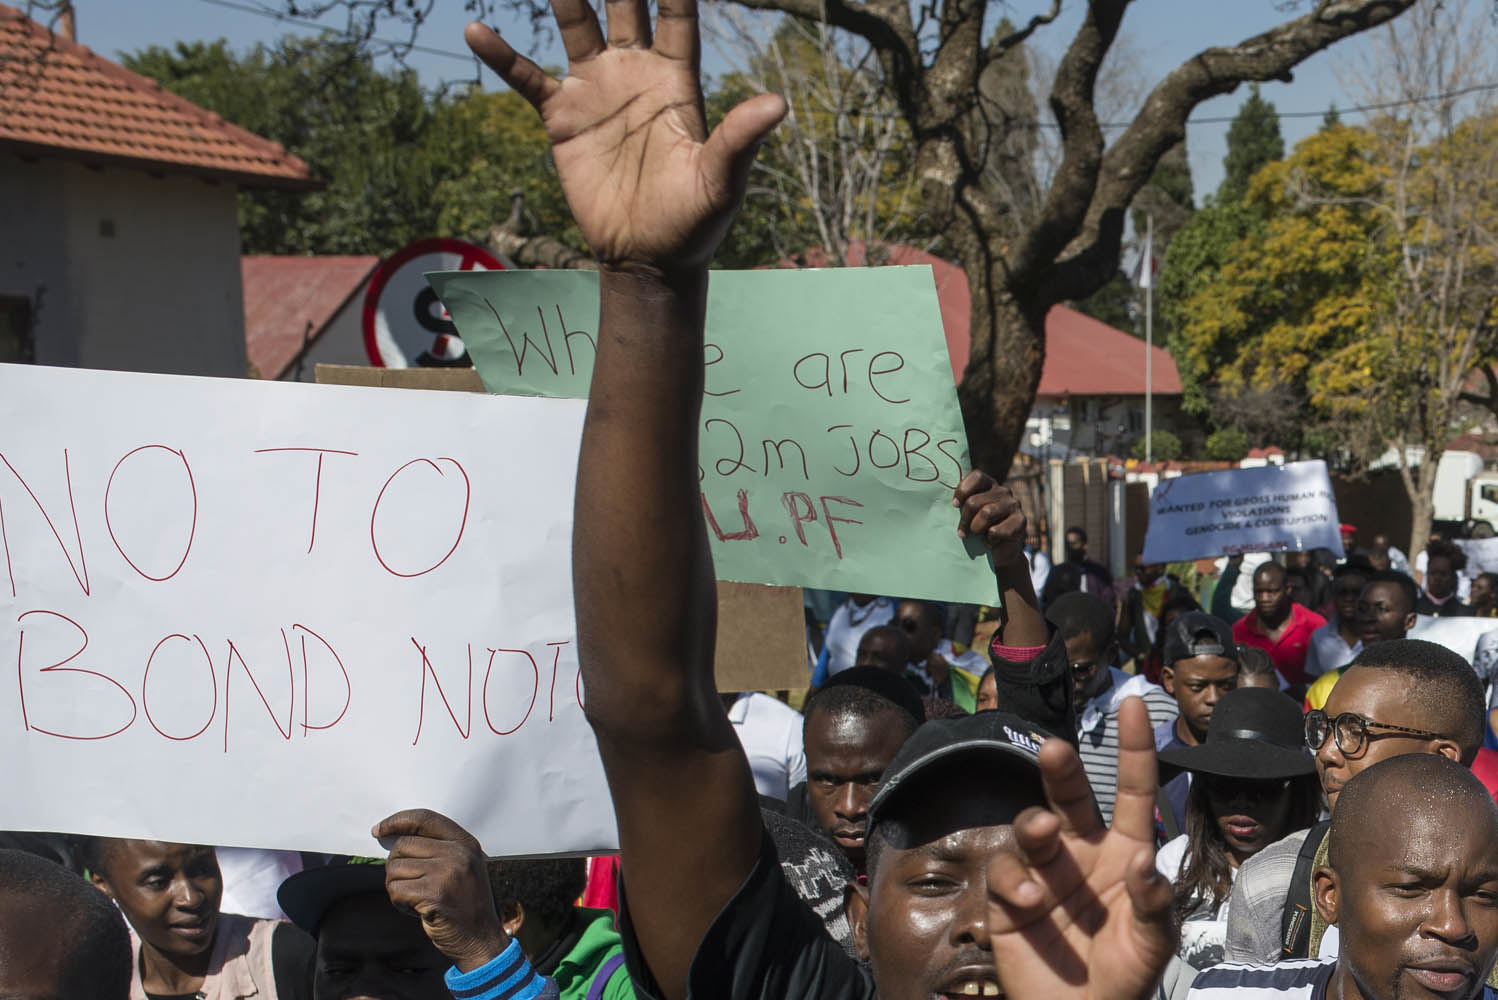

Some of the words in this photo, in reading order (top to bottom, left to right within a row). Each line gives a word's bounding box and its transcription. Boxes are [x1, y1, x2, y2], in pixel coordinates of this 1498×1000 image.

[485, 298, 742, 396] Whe
[793, 348, 911, 404] are
[826, 426, 963, 490] JOBS
[0, 444, 198, 598] NO
[254, 447, 470, 578] TO
[700, 488, 865, 560] U.PF
[1209, 499, 1232, 509] FOR
[1222, 506, 1291, 519] VIOLATIONS
[1255, 514, 1328, 529] CORRUPTION
[17, 610, 351, 753] BOND
[411, 636, 586, 746] NOT
